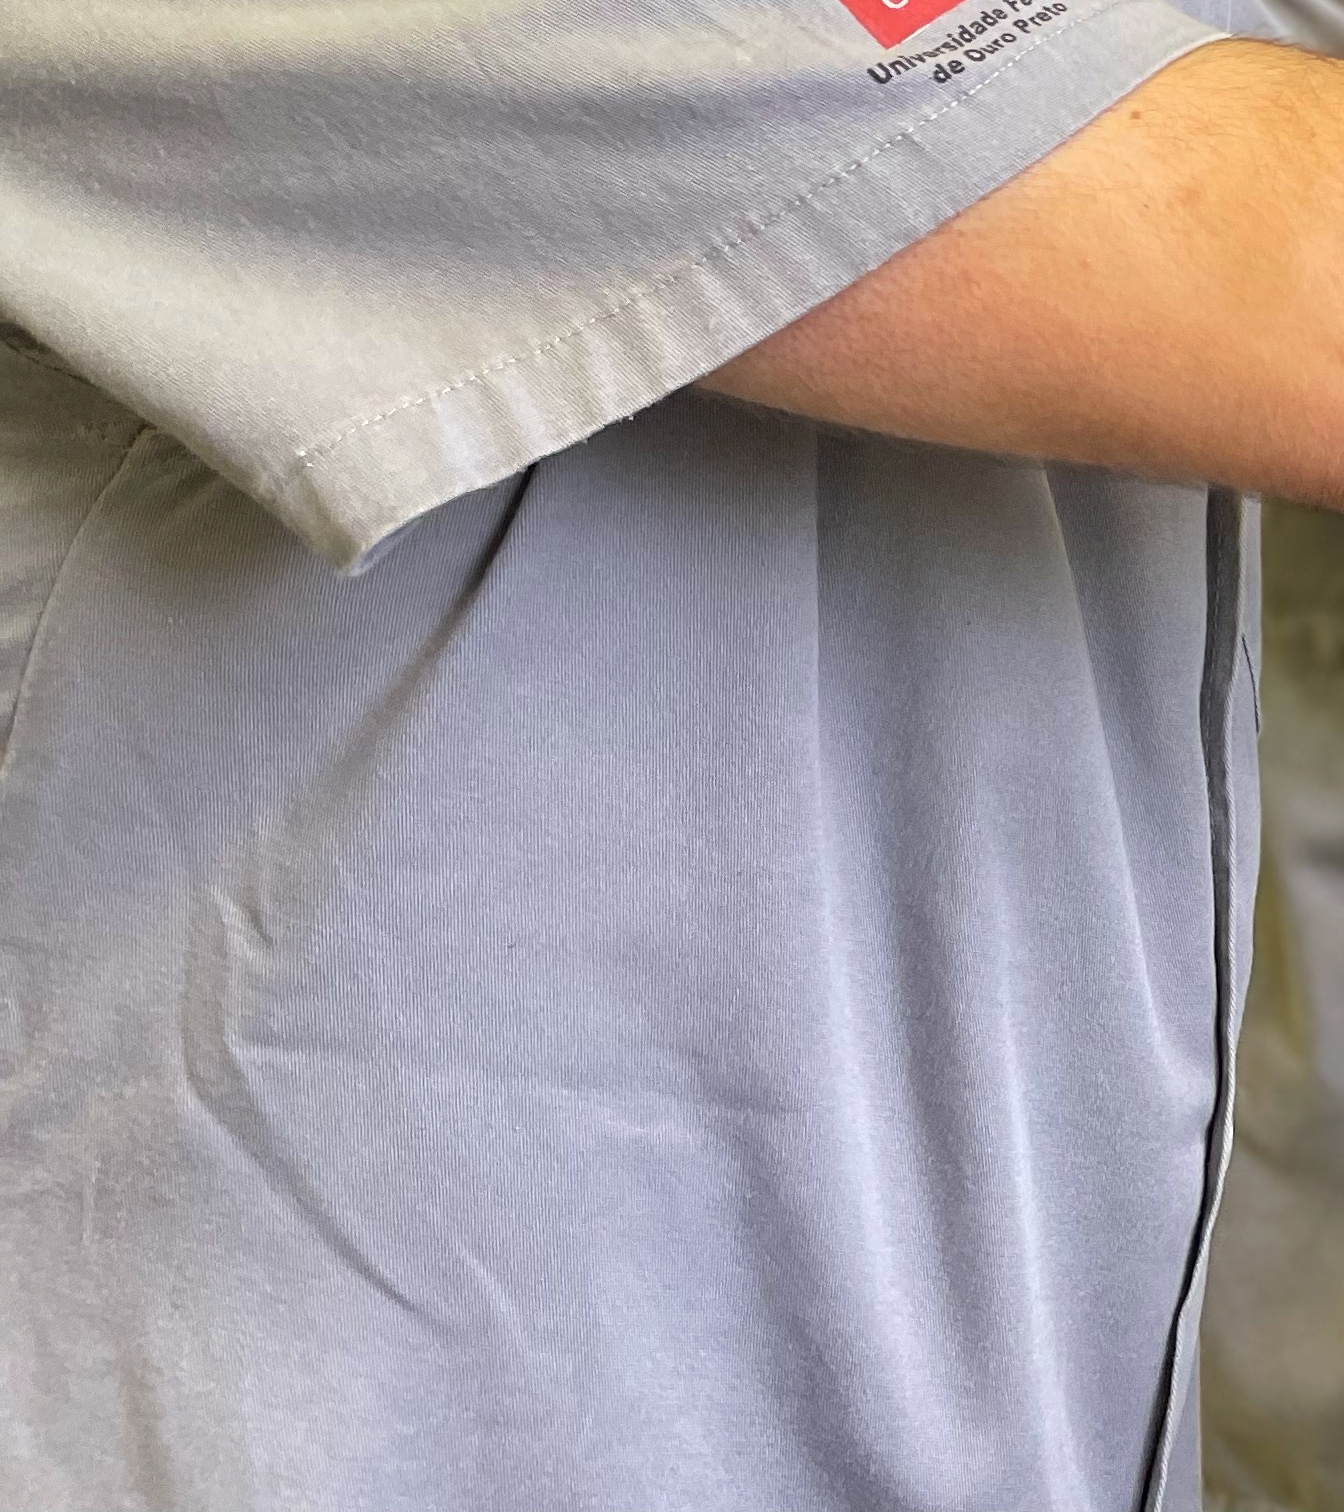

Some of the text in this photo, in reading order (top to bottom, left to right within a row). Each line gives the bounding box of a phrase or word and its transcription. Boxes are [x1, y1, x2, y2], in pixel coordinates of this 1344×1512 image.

[867, 5, 1008, 84] Universidade
[931, 2, 1068, 84] de Ouro Preto
